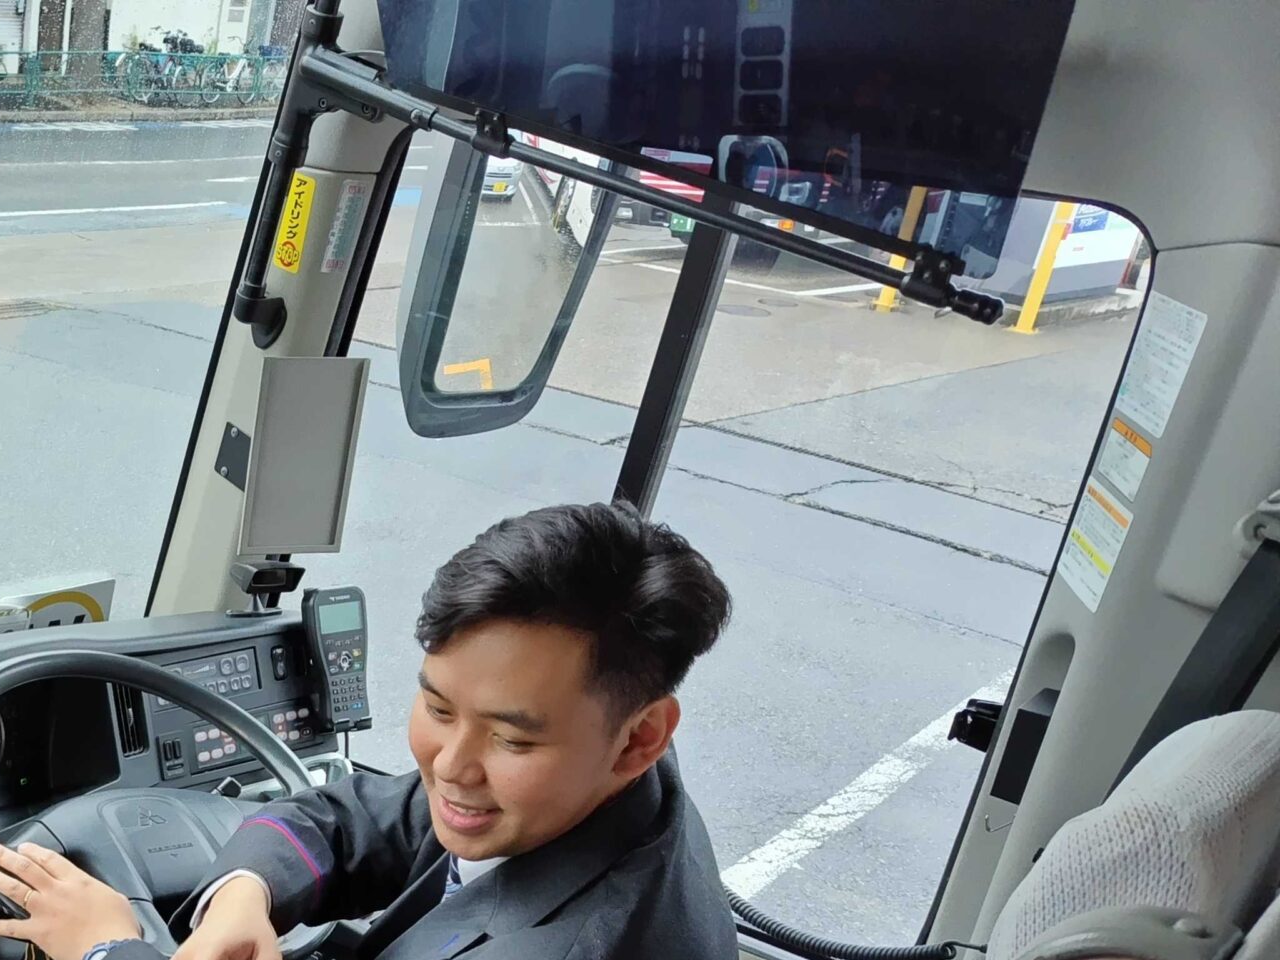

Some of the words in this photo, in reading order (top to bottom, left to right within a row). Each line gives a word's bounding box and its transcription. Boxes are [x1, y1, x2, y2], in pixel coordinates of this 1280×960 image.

[285, 177, 308, 240] アイドリング
[276, 243, 300, 264] STOP
